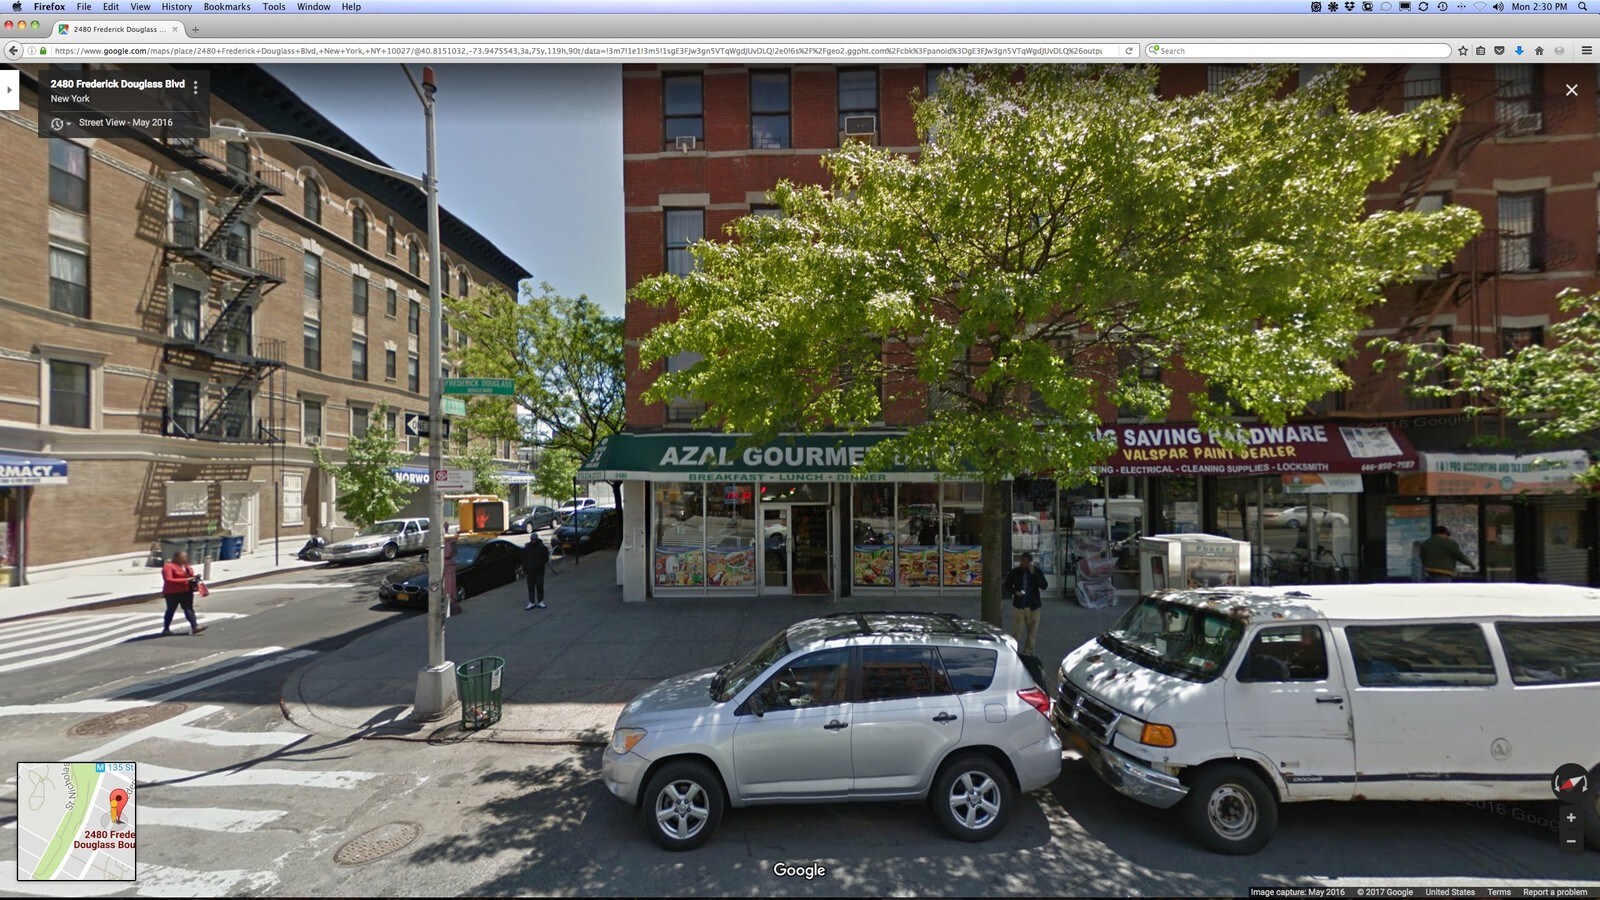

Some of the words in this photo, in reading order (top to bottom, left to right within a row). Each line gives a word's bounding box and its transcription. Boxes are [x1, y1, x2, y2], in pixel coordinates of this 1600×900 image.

[34, 3, 65, 11] Firefox
[77, 3, 91, 11] File
[104, 3, 119, 11] Edit
[131, 3, 151, 11] View
[162, 3, 192, 13] History
[204, 3, 251, 11] Bookmarks
[263, 3, 286, 11] Tools
[297, 3, 331, 11] Window
[342, 3, 361, 13] Help
[1512, 2, 1530, 10] Mon
[1533, 2, 1552, 10] 2:30
[1555, 2, 1568, 10] PM
[126, 26, 158, 34] Douglass
[1161, 47, 1185, 55] Search
[482, 380, 512, 388] DOUGLASS
[1124, 428, 1202, 446] SAVING
[659, 446, 734, 466] AZAL
[1123, 448, 1188, 461] VALSPAR
[1194, 447, 1234, 460] PAINT
[1120, 465, 1174, 474] ELECTRICAL
[1181, 464, 1226, 473] CLEANING
[1227, 464, 1270, 473] SUPPLIES
[1276, 462, 1329, 472] LOCKSMITH
[108, 764, 124, 772] 135
[125, 764, 134, 772] St
[62, 763, 76, 800] Nicholas
[66, 801, 76, 810] St
[84, 830, 108, 839] 2480
[74, 840, 116, 850] Douglass
